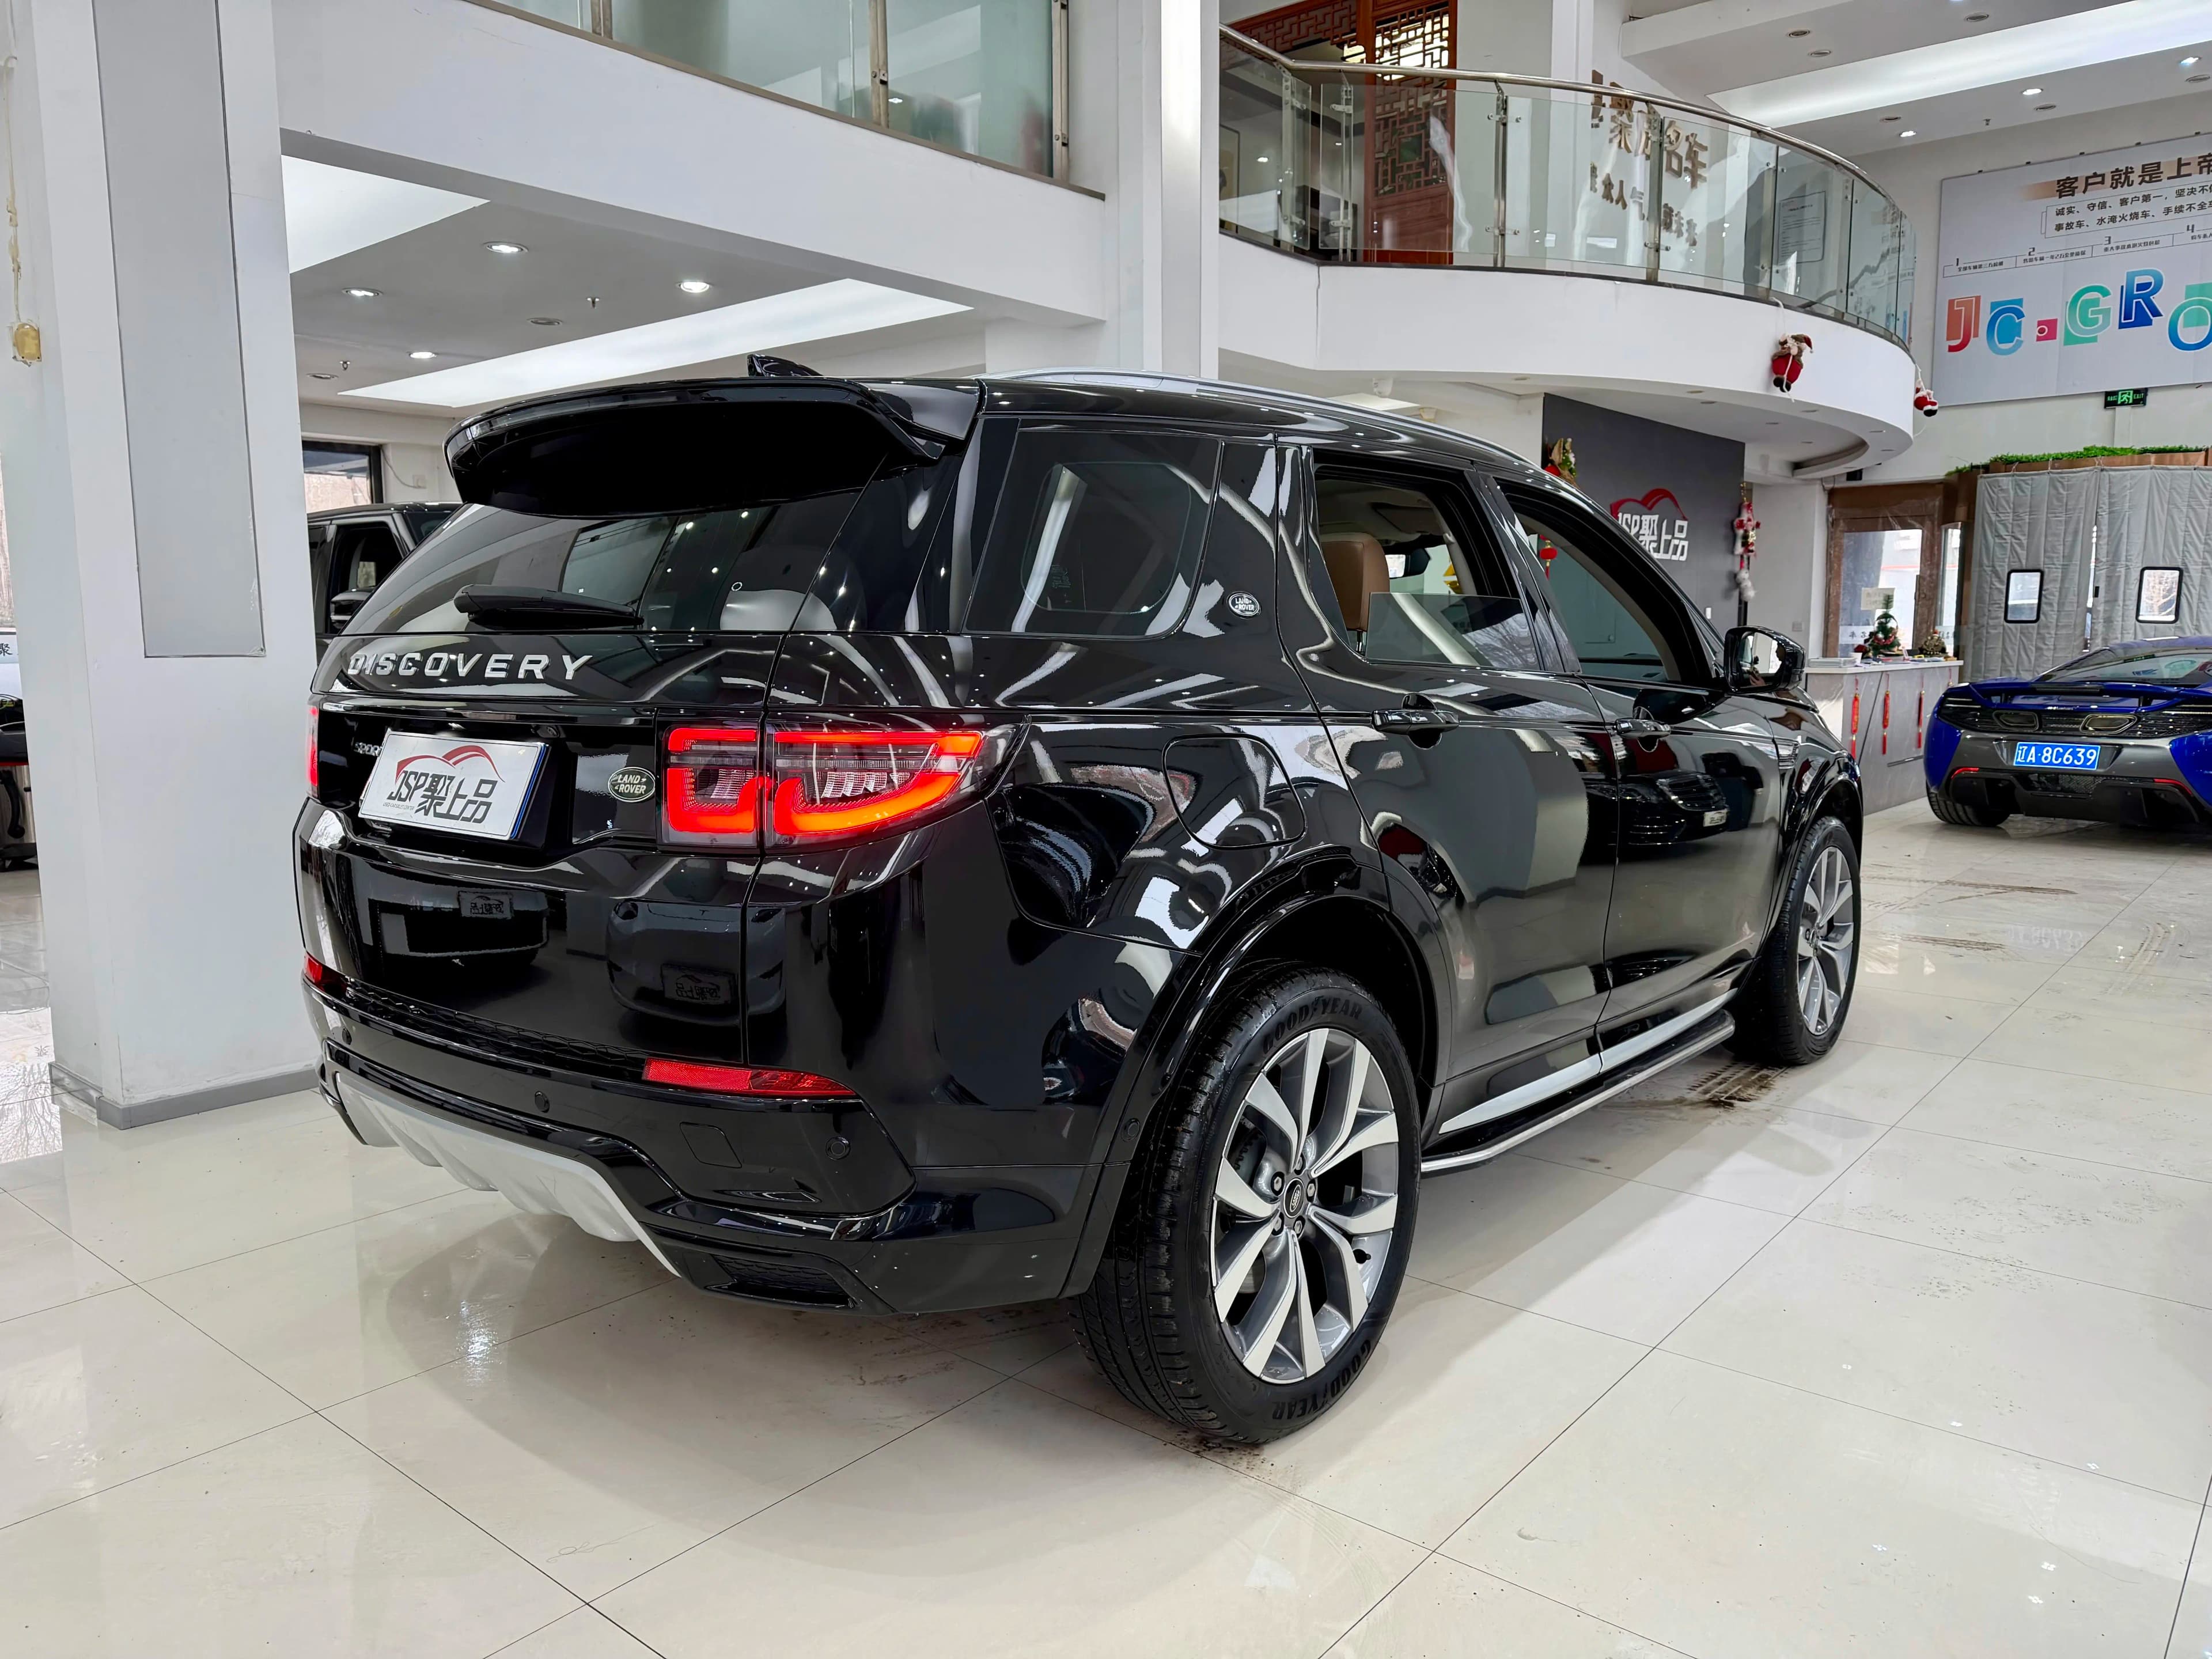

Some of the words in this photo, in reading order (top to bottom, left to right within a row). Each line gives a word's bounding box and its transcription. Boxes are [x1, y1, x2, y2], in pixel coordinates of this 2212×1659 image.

[2055, 153, 2212, 199] 客户就是上帝
[2055, 183, 2212, 217] 诚实、守信、客户第一，坚决不
[2187, 224, 2195, 233] 4
[2104, 236, 2111, 245] 3
[2028, 247, 2036, 256] 2
[347, 652, 593, 680] DISCOVERY
[354, 742, 382, 756] SPOR
[617, 774, 641, 784] LAND
[619, 784, 646, 794] ROVER
